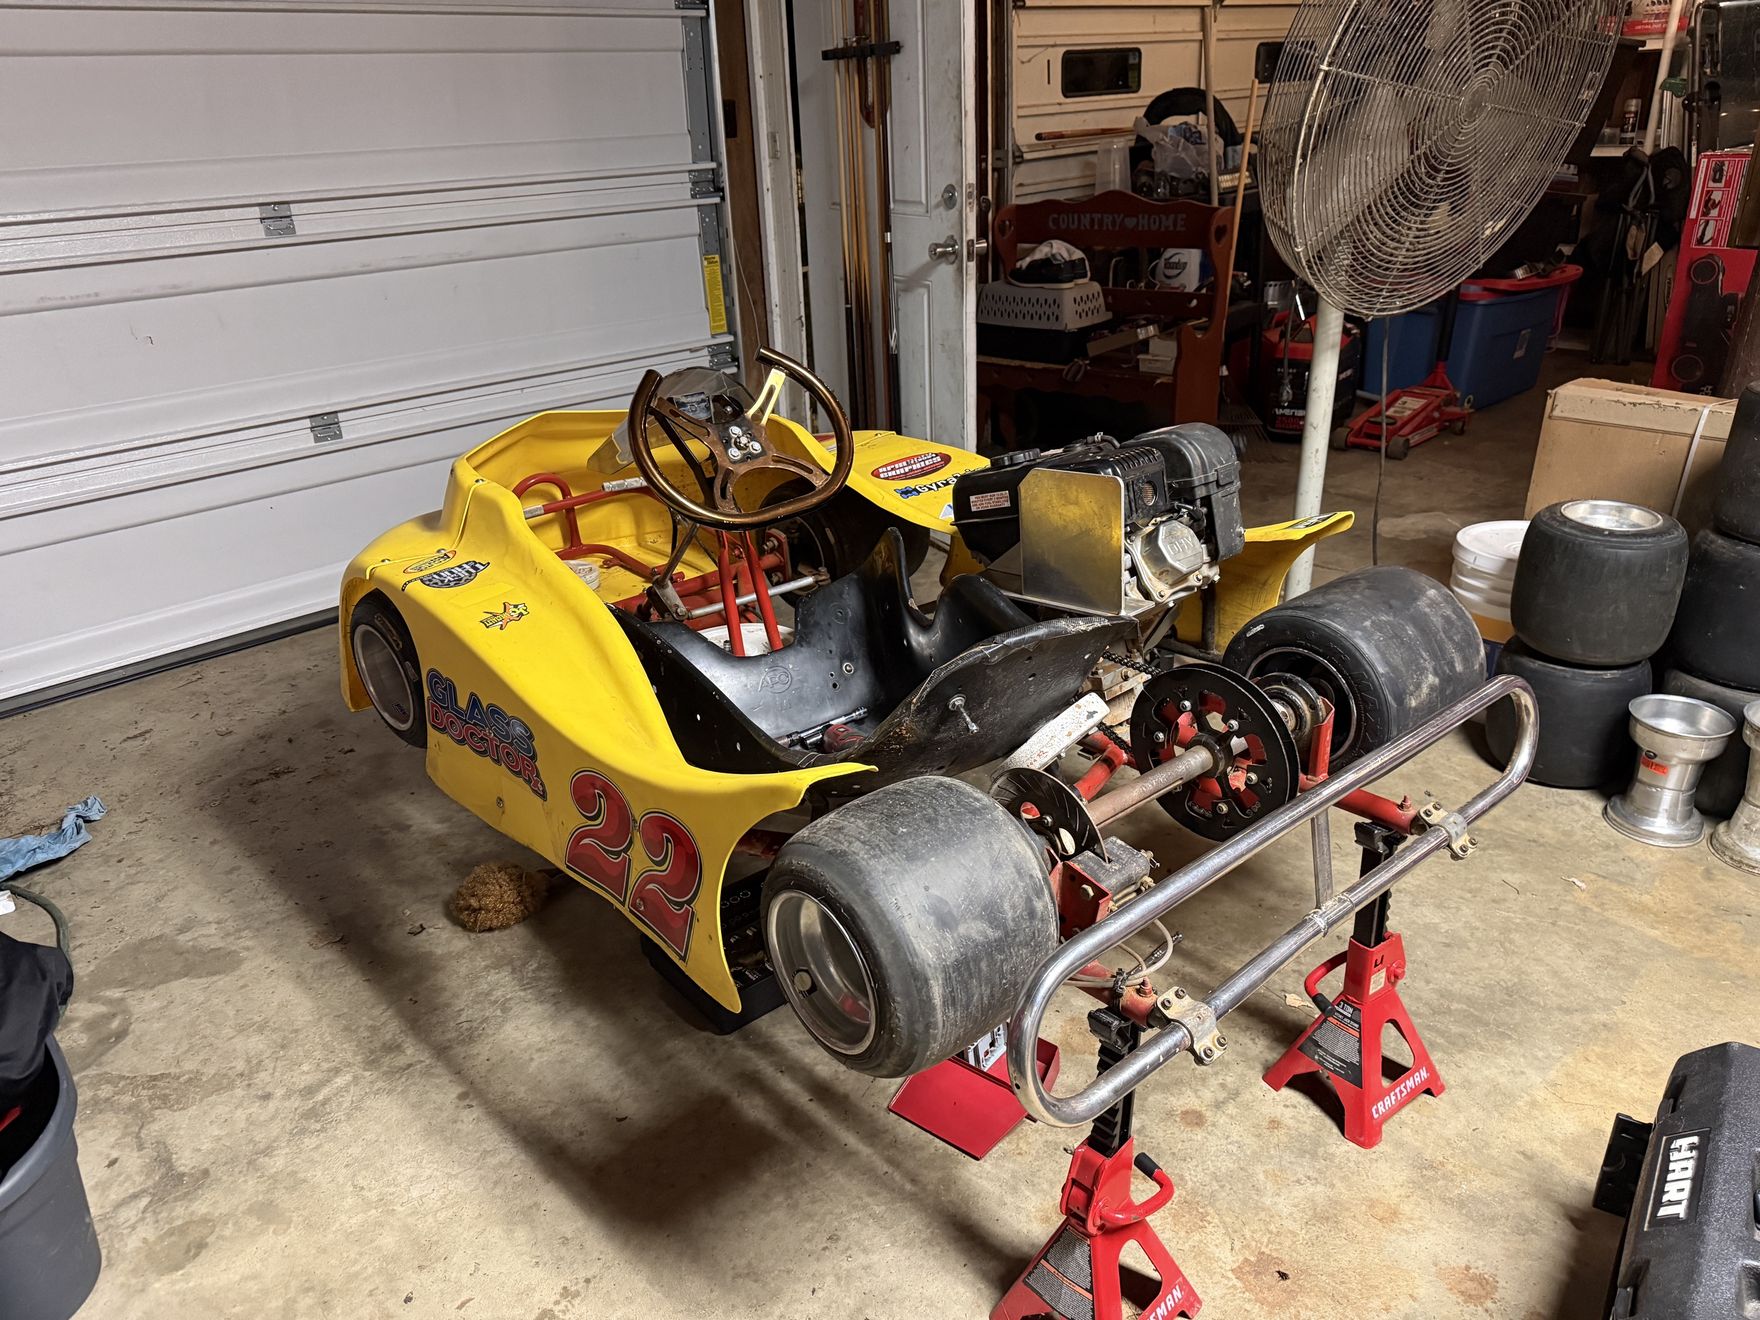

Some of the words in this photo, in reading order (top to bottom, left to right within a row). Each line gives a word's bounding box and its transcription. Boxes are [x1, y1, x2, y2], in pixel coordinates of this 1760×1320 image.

[1049, 213, 1122, 231] COUNTRY
[1138, 213, 1186, 231] HOME
[880, 456, 942, 479] GRAPHICS
[427, 669, 536, 760] GLASS
[565, 768, 702, 965] 22
[1371, 1066, 1428, 1119] CRAFTSMAN
[1656, 1135, 1700, 1220] HART
